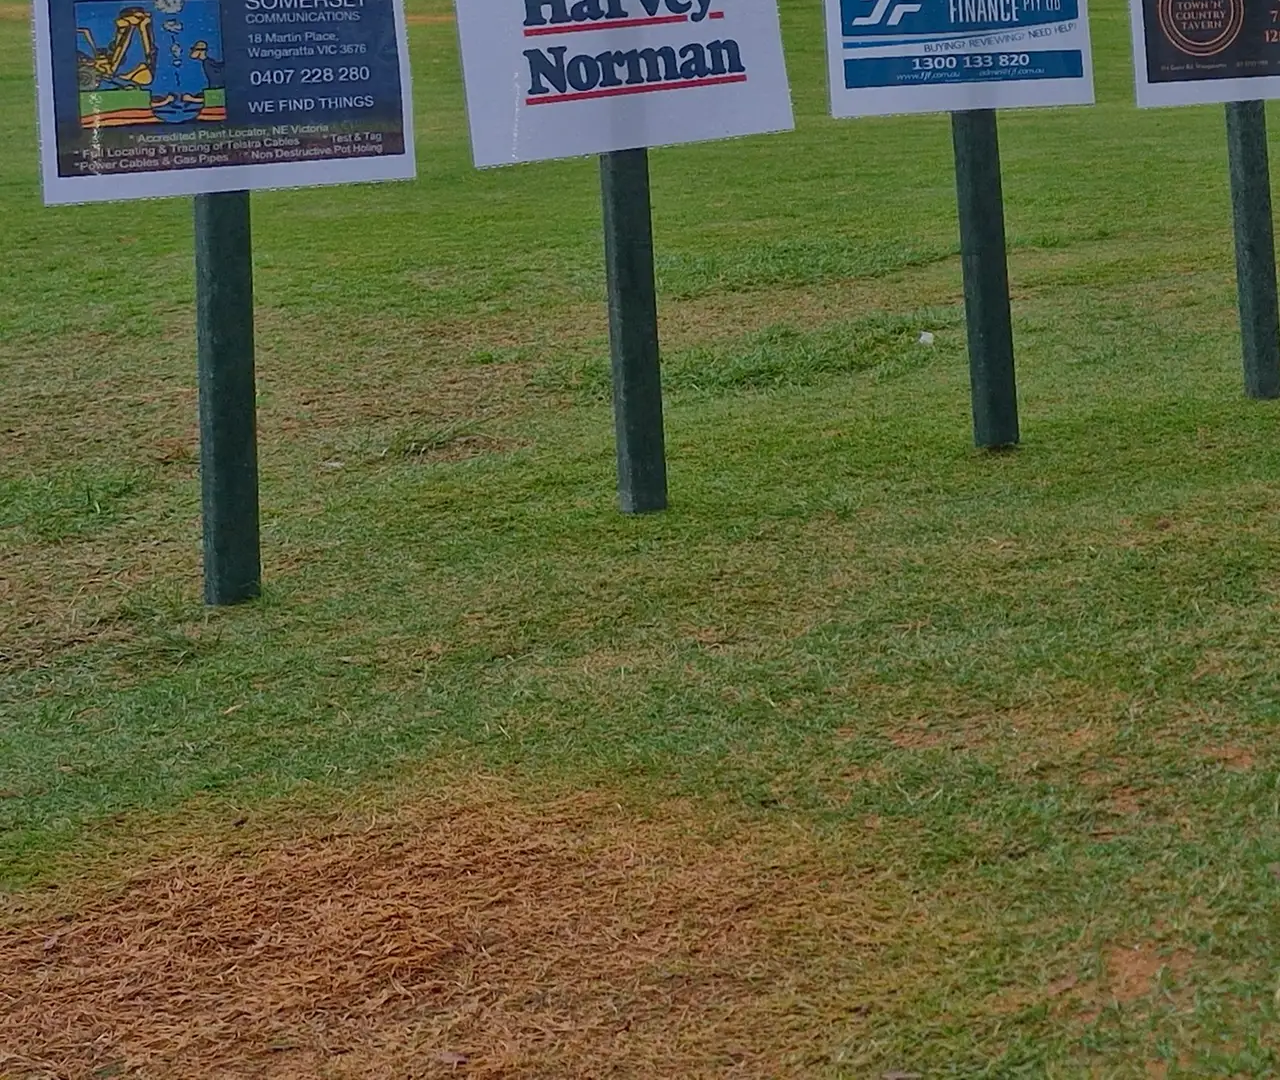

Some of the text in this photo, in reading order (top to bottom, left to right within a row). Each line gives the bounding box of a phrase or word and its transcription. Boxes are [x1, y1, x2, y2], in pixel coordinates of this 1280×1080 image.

[1177, 0, 1209, 10] TOWN
[245, 11, 361, 24] COMMUNICATIONS
[1175, 10, 1226, 20] COUNTRY
[1270, 10, 1278, 23] 7
[1181, 20, 1222, 30] TAVERN
[248, 31, 339, 43] 18 Martin Place,
[924, 23, 1078, 53] BUYING? REVIEWING? NEED HELP?
[248, 45, 314, 59] Wangaratta
[317, 44, 337, 55] VIC
[522, 38, 746, 96] Norman
[912, 54, 1030, 70] 1300 133 820
[250, 66, 370, 85] 0407 228 280
[248, 95, 374, 113] WE FIND THINGS
[137, 130, 195, 143] Accredited
[198, 128, 227, 140] Plant
[272, 125, 289, 135] NE
[290, 123, 329, 134] Victoria
[331, 131, 382, 143] Test & Tag
[107, 146, 155, 158] Locating
[159, 144, 167, 154] &
[170, 142, 210, 154] Tracing
[226, 138, 261, 150] Telstra
[264, 136, 300, 147] Cables
[334, 144, 351, 154] Pot
[353, 142, 383, 155] Holing
[120, 156, 159, 168] Cables
[162, 156, 170, 166] &
[173, 154, 196, 165] Gas
[199, 152, 229, 164] Pipes
